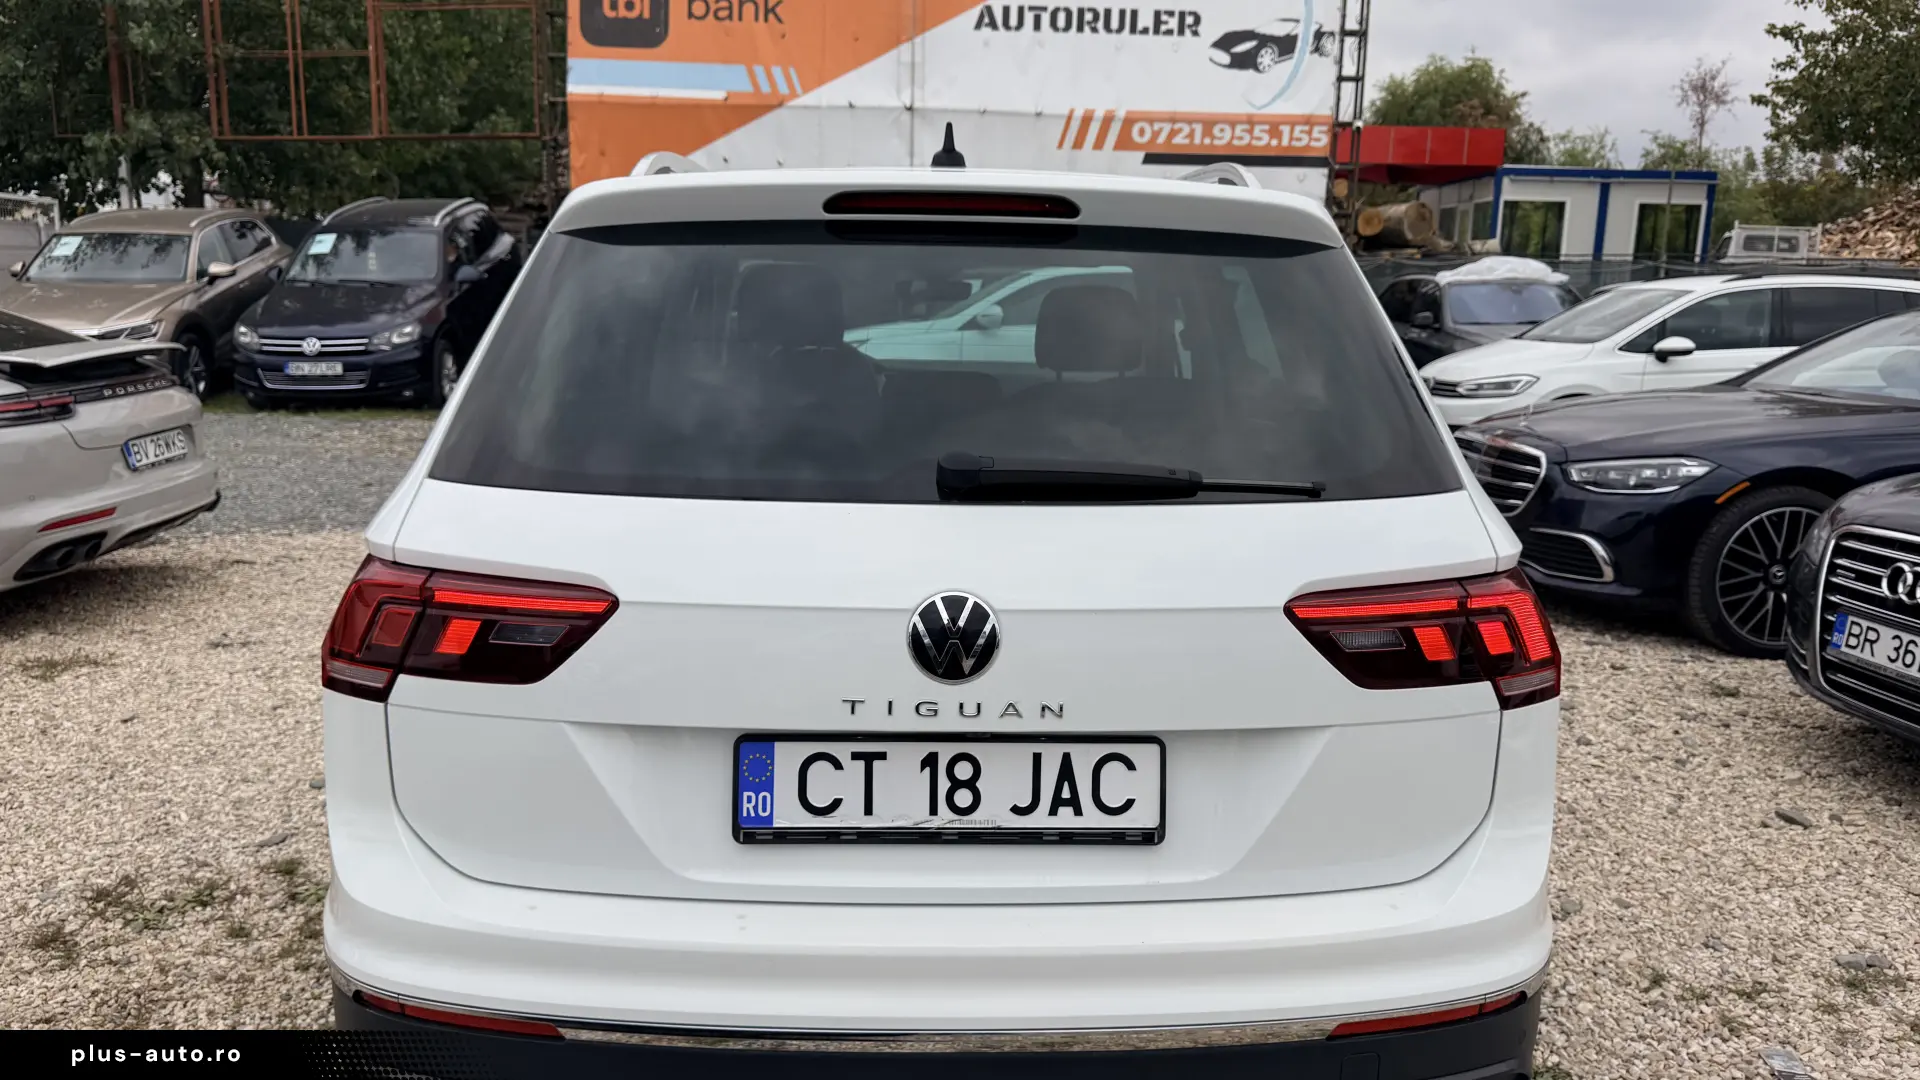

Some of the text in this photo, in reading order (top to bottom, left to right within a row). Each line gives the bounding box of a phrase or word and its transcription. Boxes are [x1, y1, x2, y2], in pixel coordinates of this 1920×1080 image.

[687, 0, 783, 23] bank
[974, 5, 1202, 37] AUTORULER
[1131, 121, 1329, 148] 0721.955.155
[103, 380, 169, 396] PORSCHE
[1845, 620, 1880, 657] BR
[842, 697, 1065, 719] TIGUAN
[797, 751, 1137, 817] CT 18 JAC
[742, 791, 771, 817] RO
